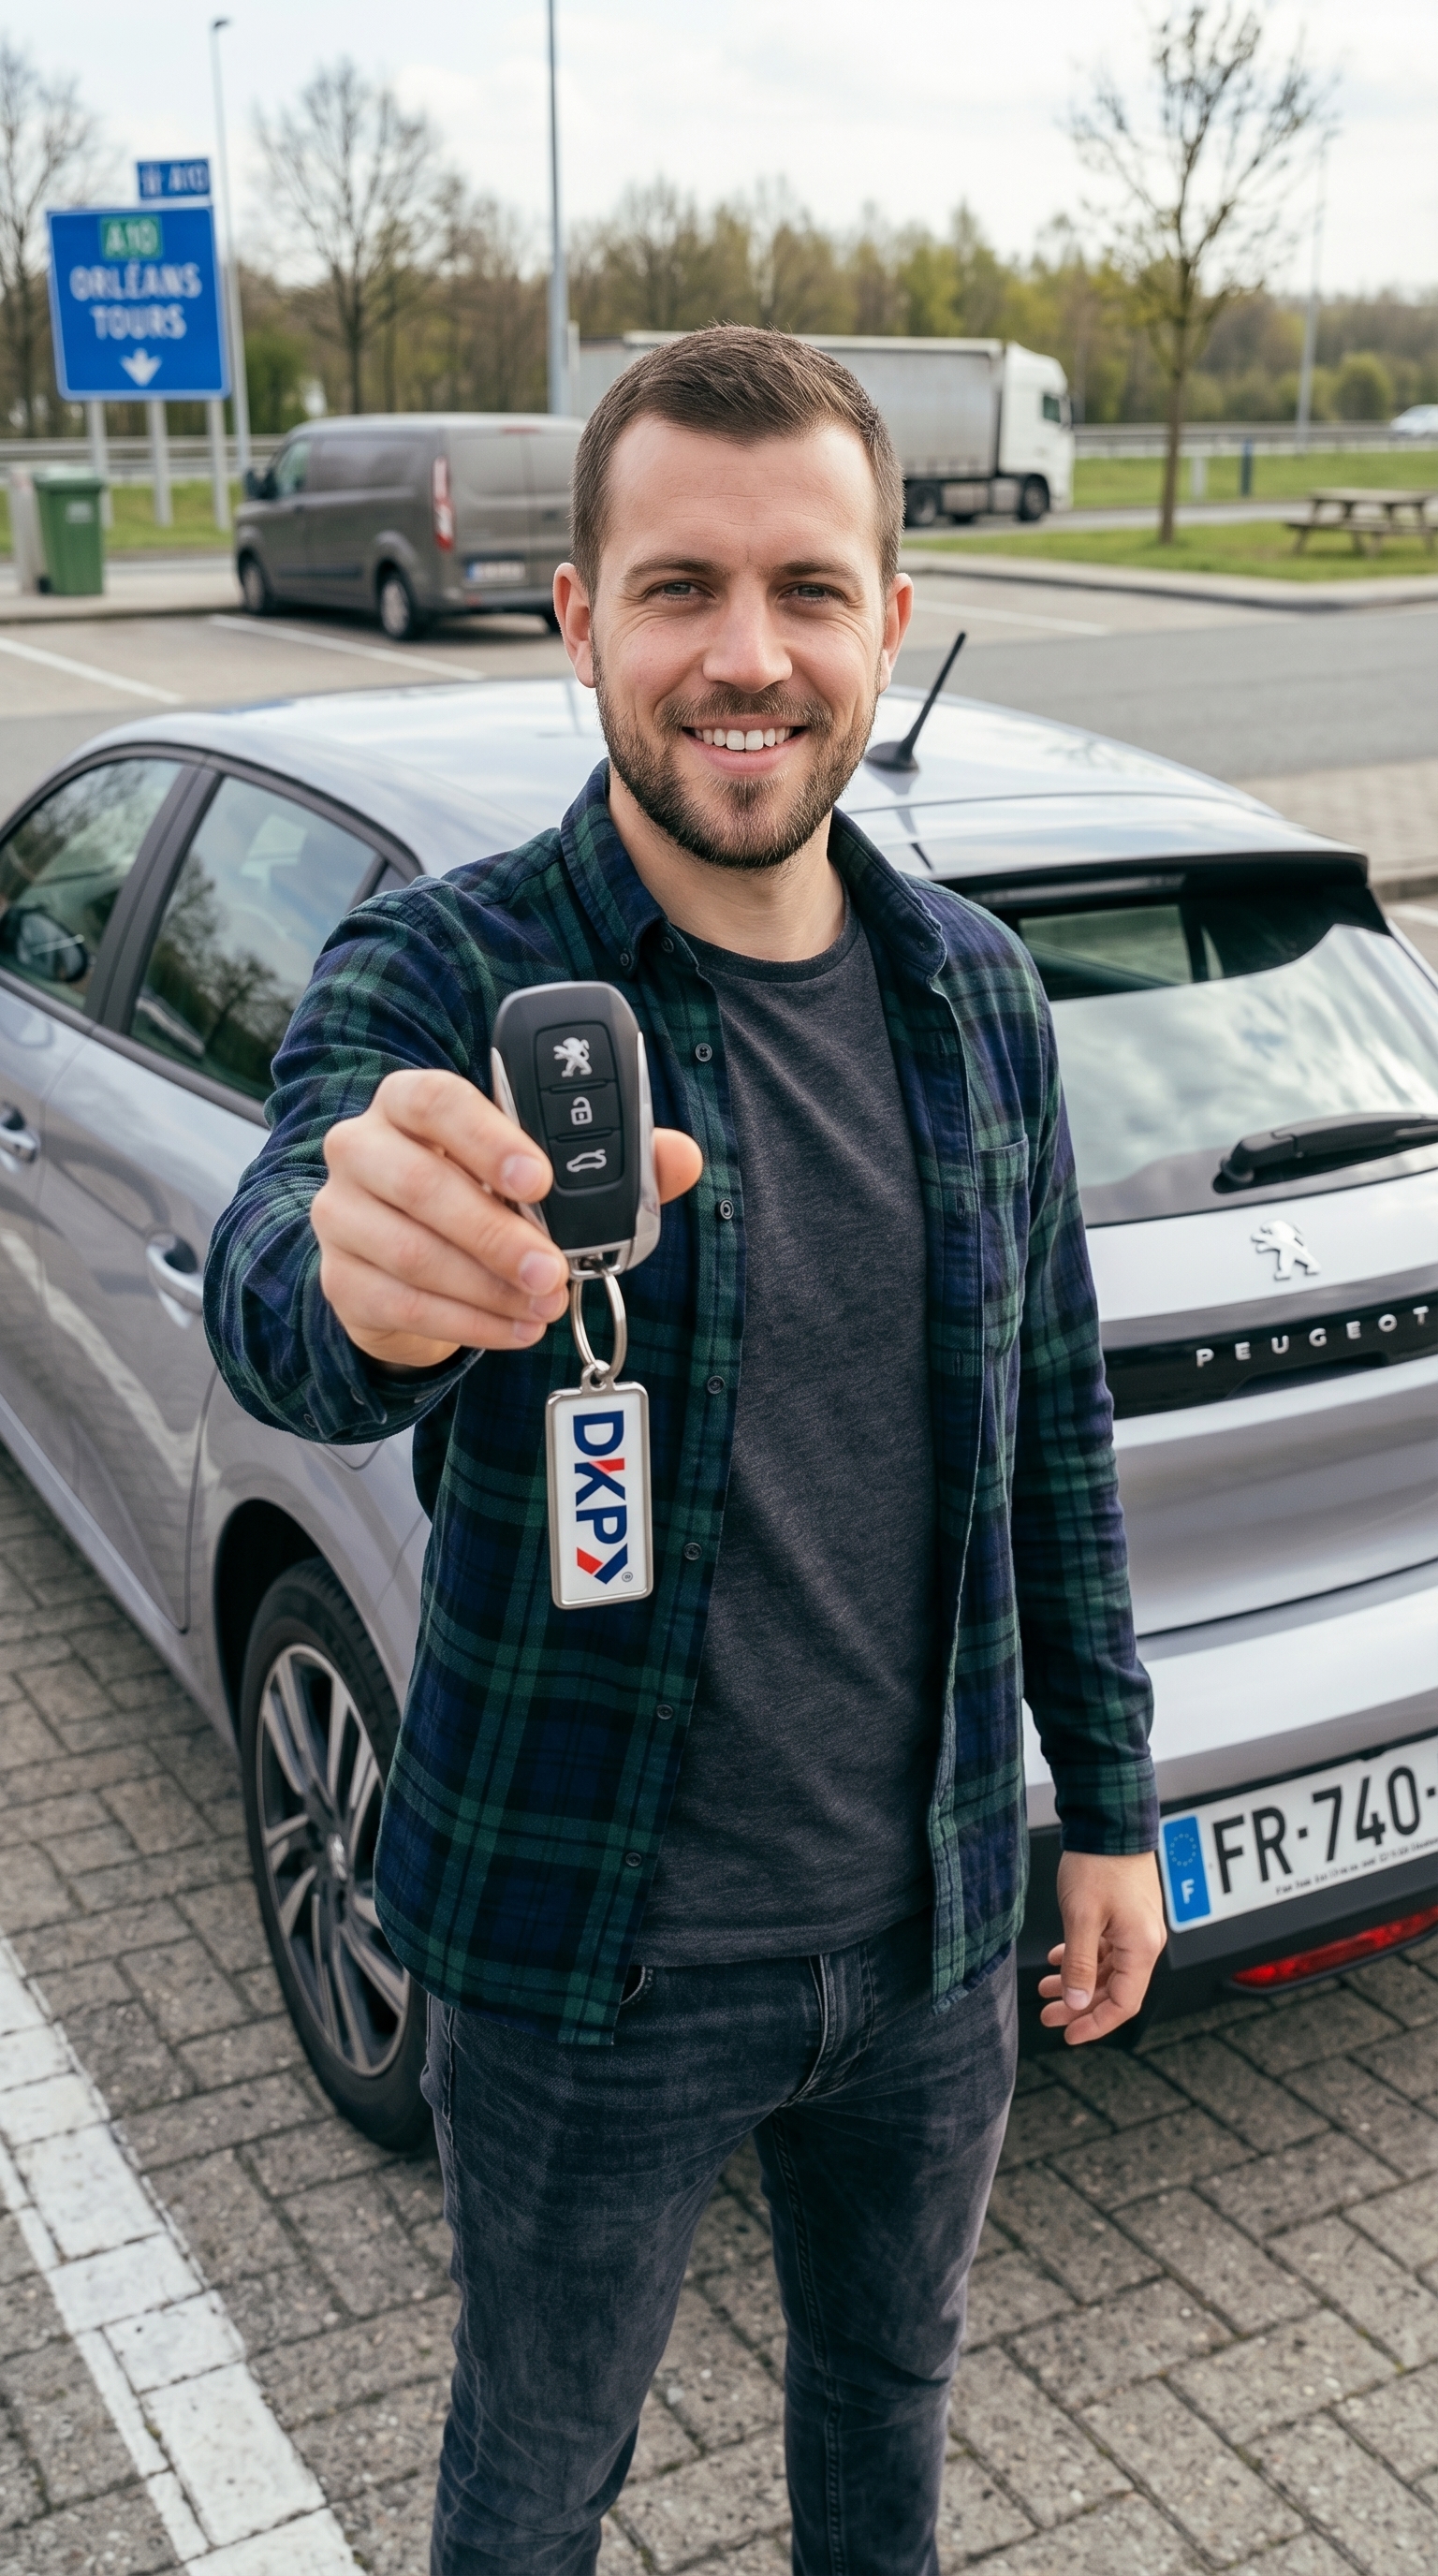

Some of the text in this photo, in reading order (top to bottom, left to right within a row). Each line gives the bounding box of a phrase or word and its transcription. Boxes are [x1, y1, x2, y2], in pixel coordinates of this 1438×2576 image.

[69, 258, 202, 301] ORLÉANS
[89, 303, 187, 340] TOURS
[1196, 1306, 1429, 1368] PEUGEOT
[1181, 1878, 1195, 1905] F
